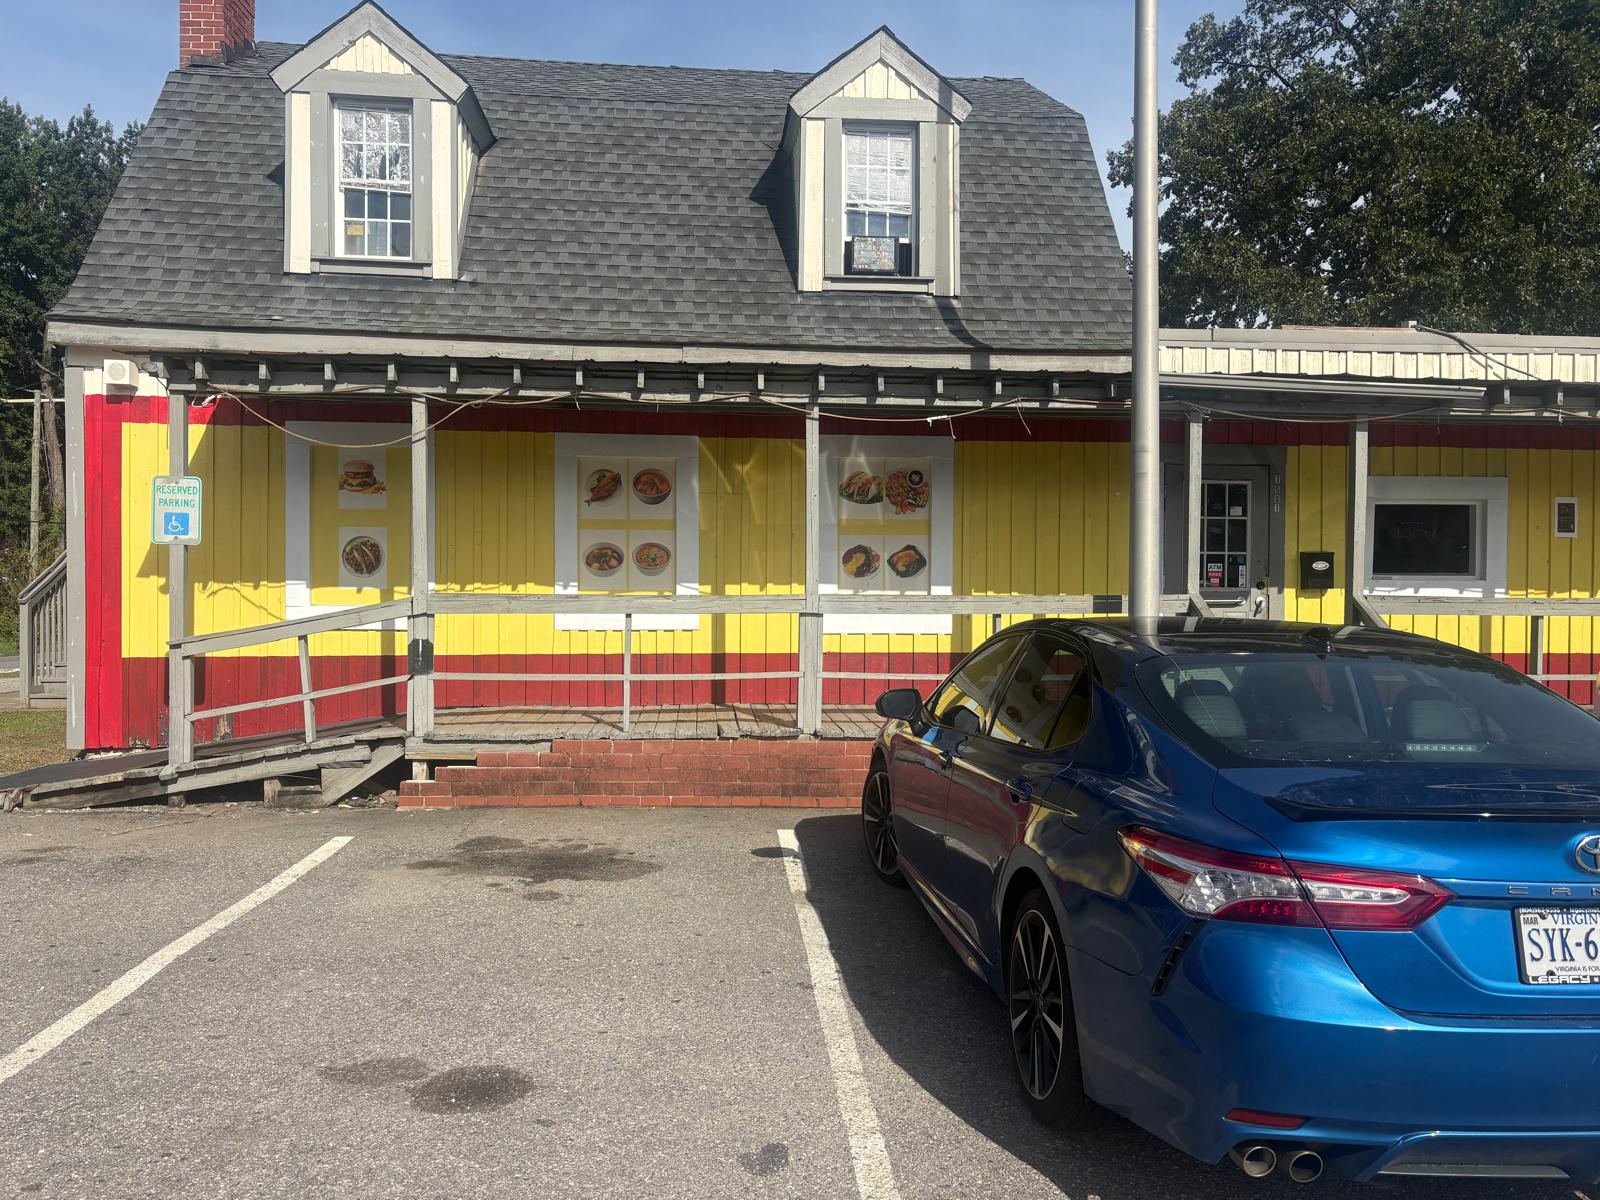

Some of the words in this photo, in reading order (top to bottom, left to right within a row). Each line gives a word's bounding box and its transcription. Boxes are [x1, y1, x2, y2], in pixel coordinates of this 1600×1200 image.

[156, 485, 198, 495] RESERVED
[158, 498, 195, 508] PARKING
[1522, 916, 1539, 925] MAR
[1551, 913, 1598, 925] VIRGIN
[1527, 927, 1599, 962] SYK-6
[1529, 975, 1591, 984] LEGACY
